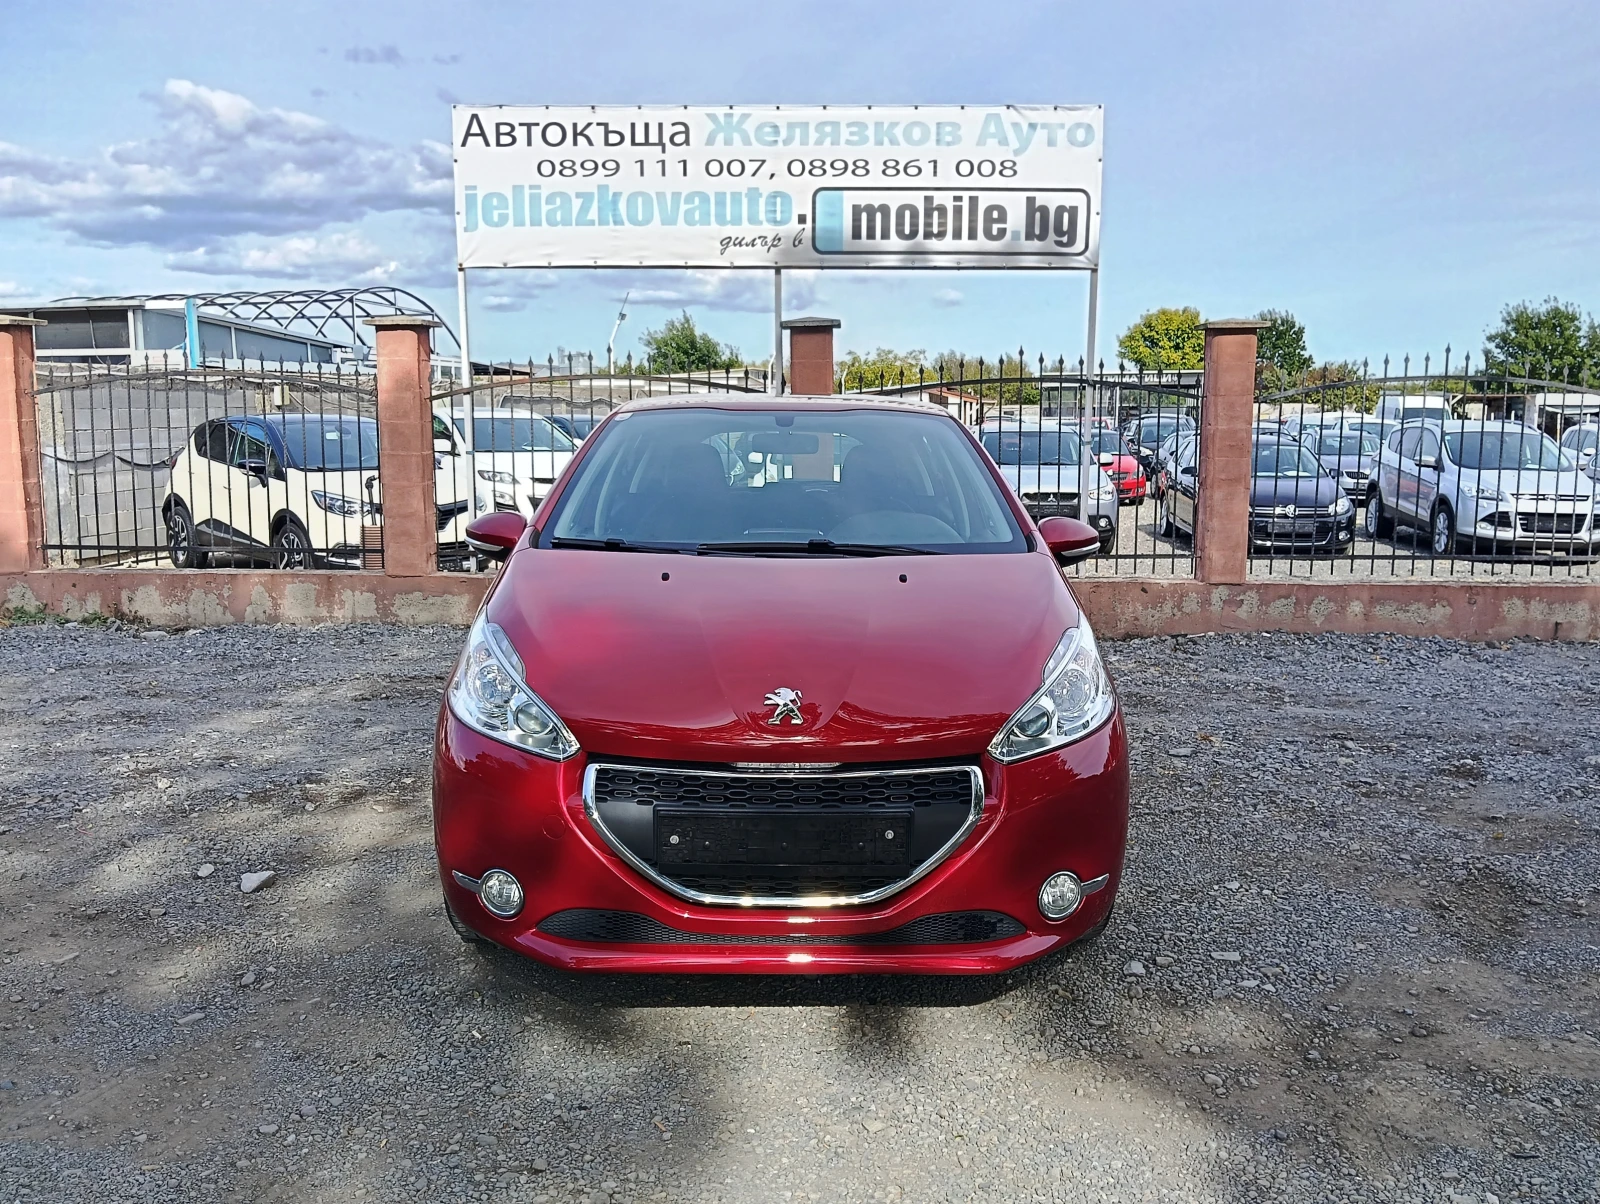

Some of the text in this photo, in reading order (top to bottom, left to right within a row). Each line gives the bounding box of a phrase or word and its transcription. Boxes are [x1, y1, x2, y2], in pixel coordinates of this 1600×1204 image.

[461, 110, 1095, 156] Автокъща Желязков Ауто
[537, 159, 1017, 179] 0899 111 007, 0898 861 008
[852, 196, 1078, 248] mobile.bg
[720, 234, 781, 255] дилър
